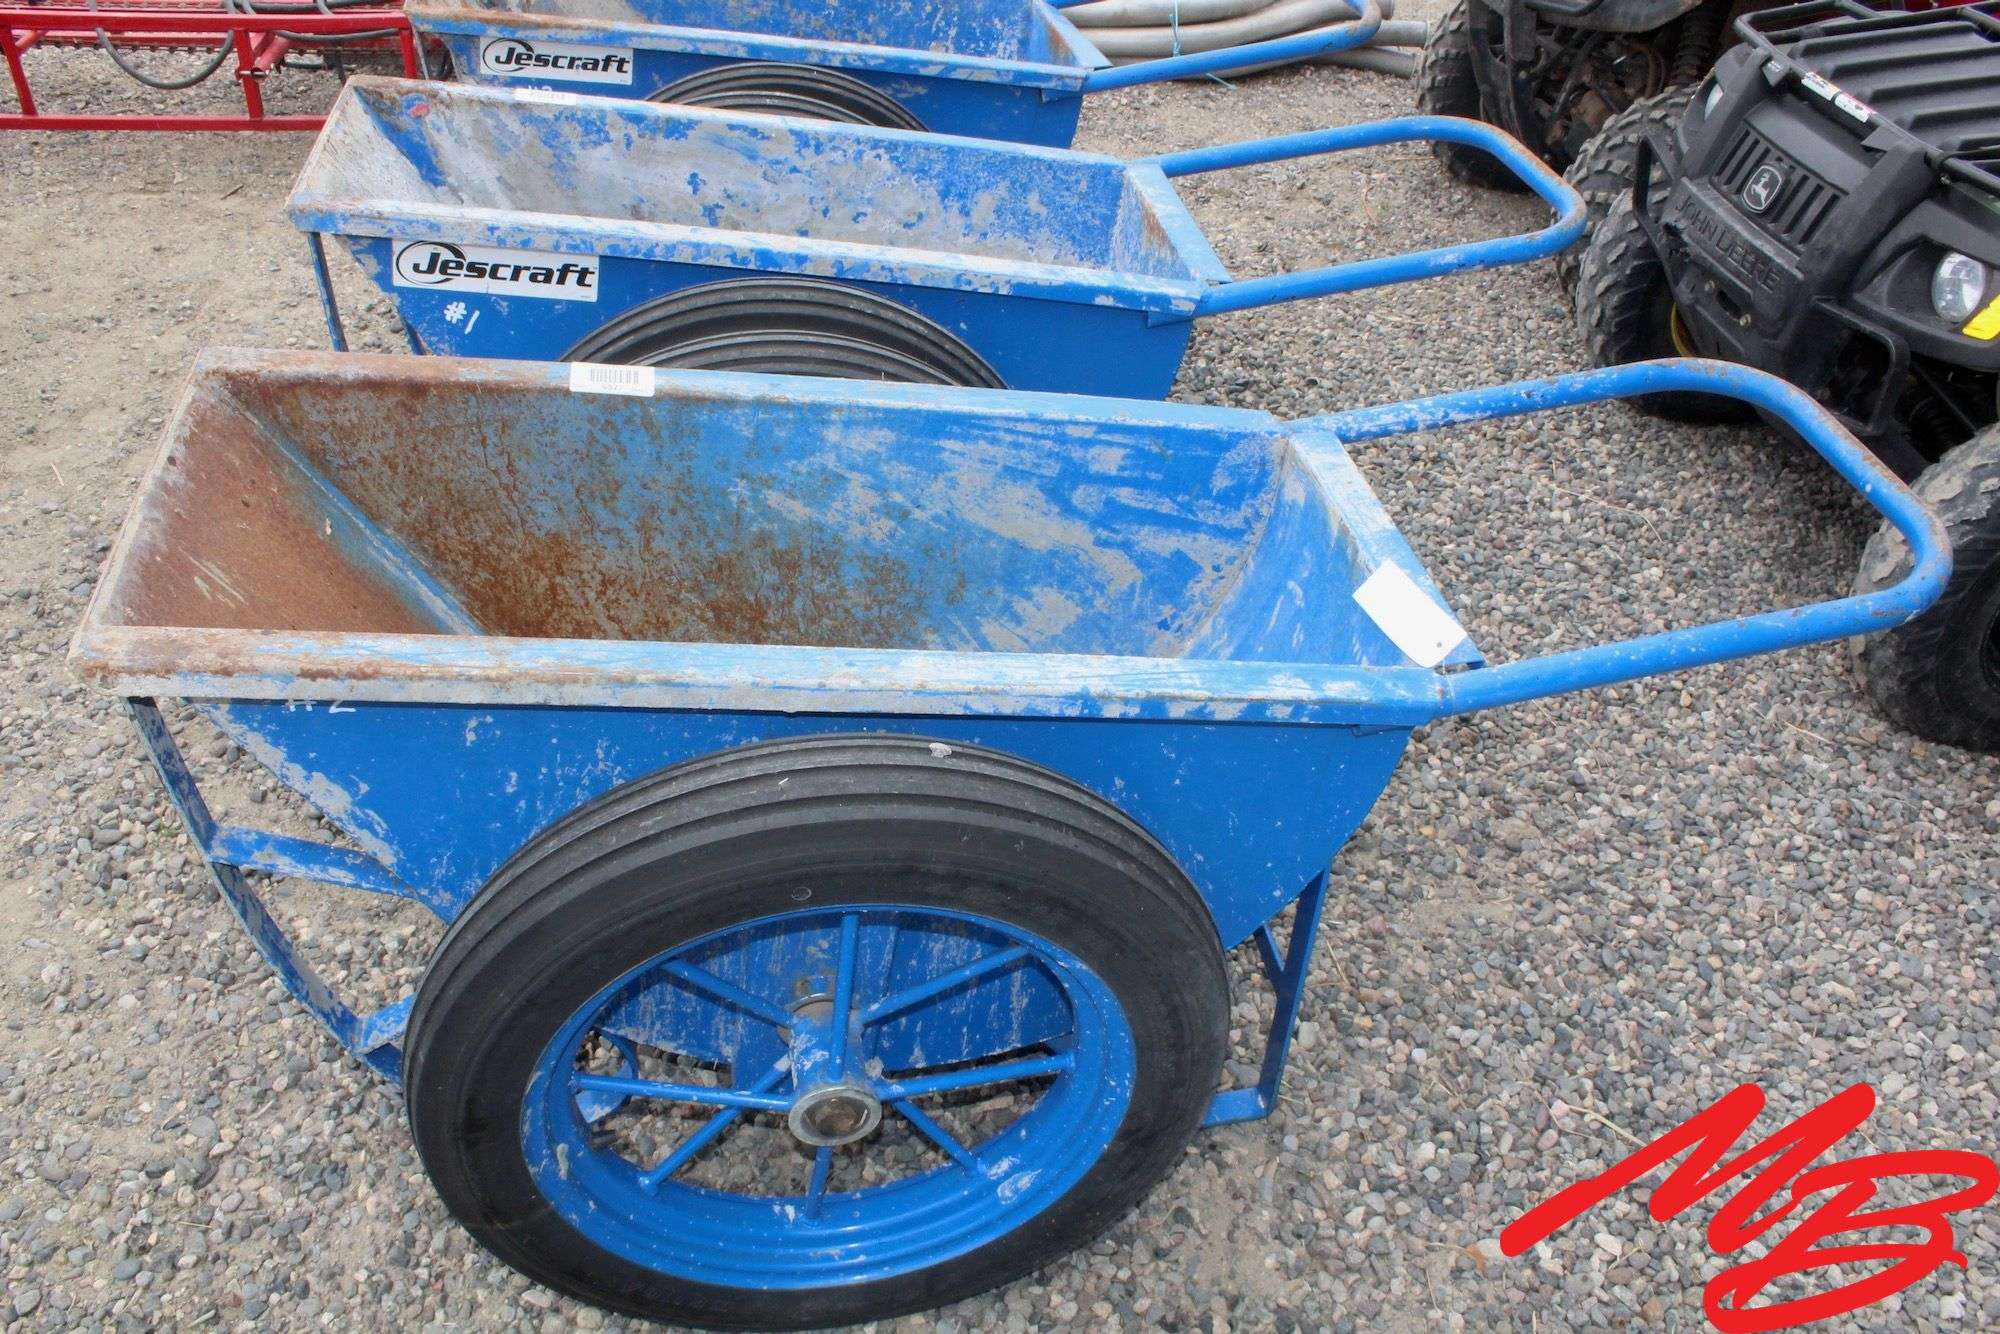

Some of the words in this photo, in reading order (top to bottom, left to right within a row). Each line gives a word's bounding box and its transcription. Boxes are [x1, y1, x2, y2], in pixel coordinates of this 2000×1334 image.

[494, 47, 631, 74] Jescraft
[1674, 195, 1719, 242] JOHN
[1715, 229, 1781, 294] DEERE
[412, 251, 596, 288] Jescraft
[443, 301, 480, 335] #1
